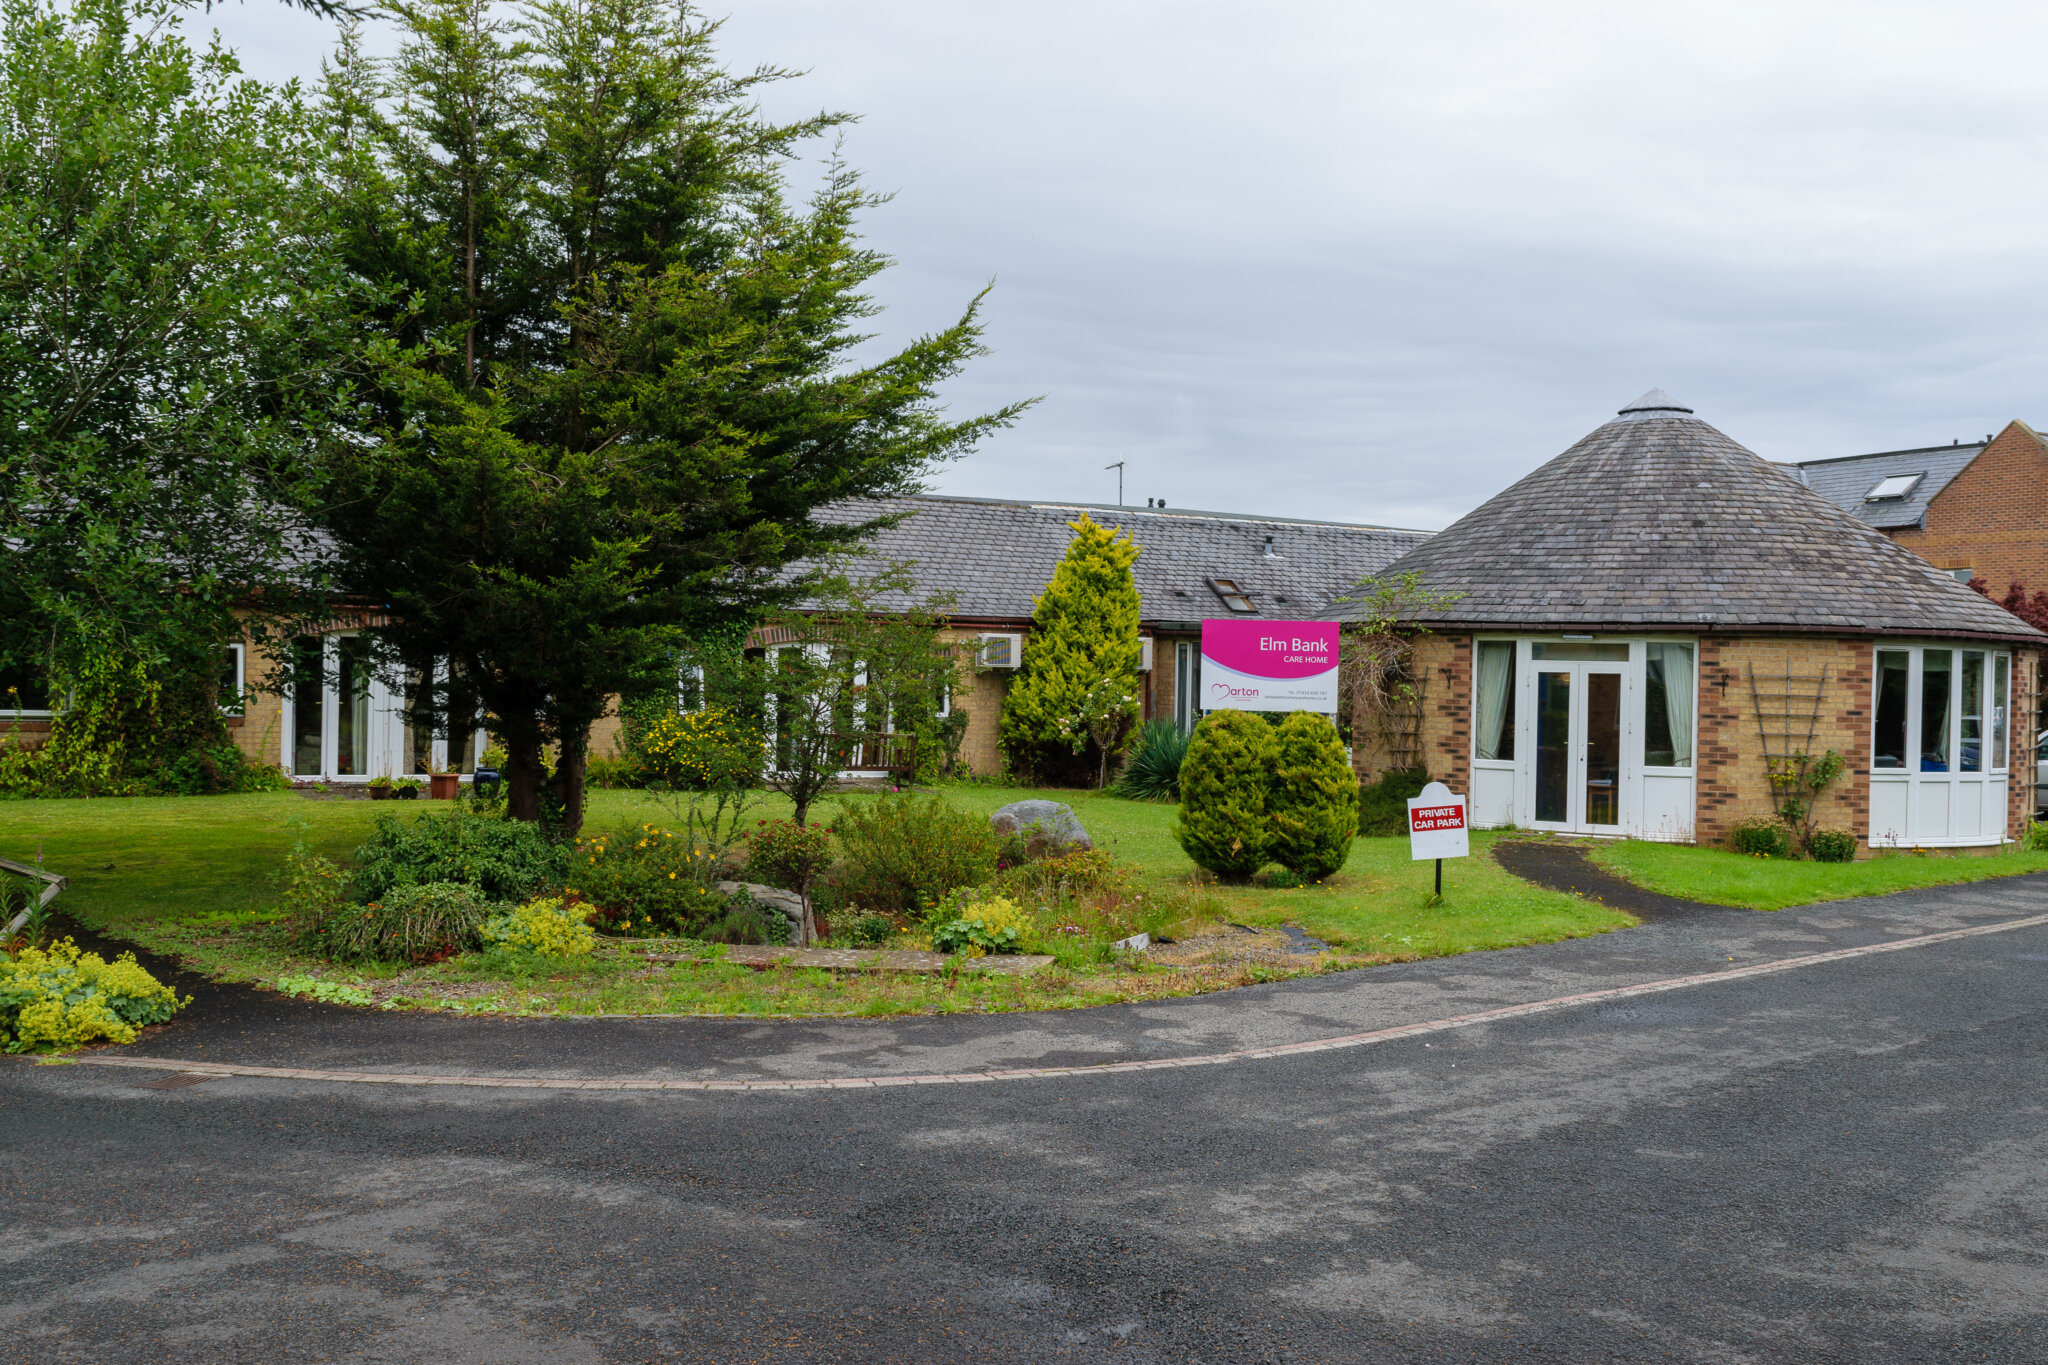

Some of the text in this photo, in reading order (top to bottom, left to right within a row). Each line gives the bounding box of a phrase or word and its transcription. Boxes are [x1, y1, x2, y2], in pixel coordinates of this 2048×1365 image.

[1260, 636, 1329, 652] Elm Bank
[1283, 655, 1304, 663] CARE
[1419, 808, 1456, 818] PRIVATE
[1414, 818, 1462, 829] CAR PARK
